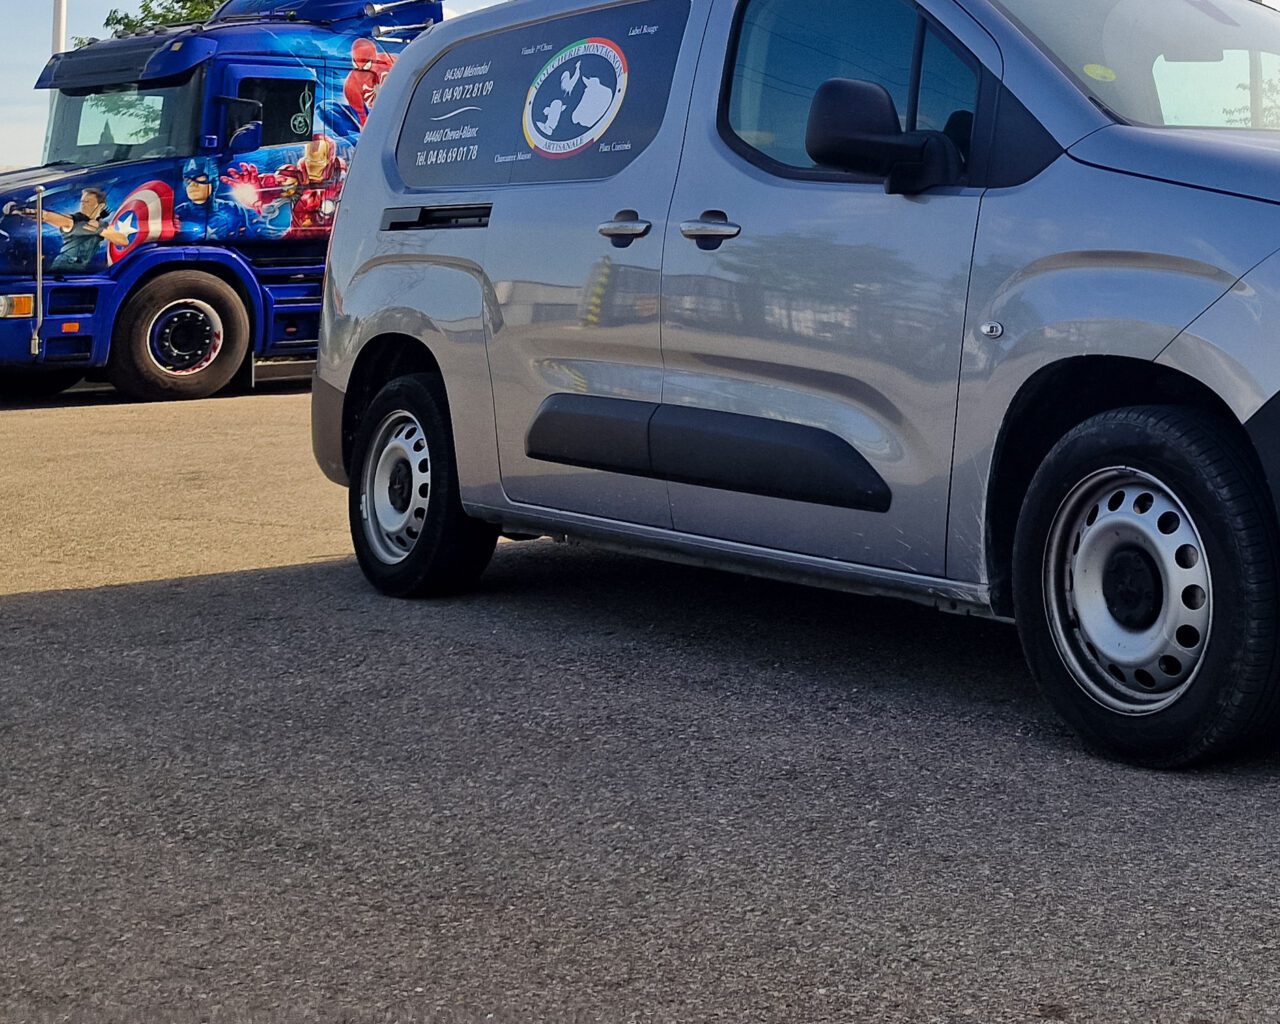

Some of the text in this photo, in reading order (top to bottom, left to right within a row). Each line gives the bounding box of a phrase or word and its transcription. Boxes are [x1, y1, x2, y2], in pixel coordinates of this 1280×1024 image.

[444, 66, 464, 81] 84360
[431, 80, 494, 105] Tél. 04 90 72 81 09
[423, 129, 443, 144] 84460
[416, 150, 426, 166] Tél.
[427, 149, 438, 165] 04
[437, 148, 447, 164] 86
[447, 147, 458, 163] 69
[457, 146, 467, 161] 01
[467, 144, 478, 160] 78
